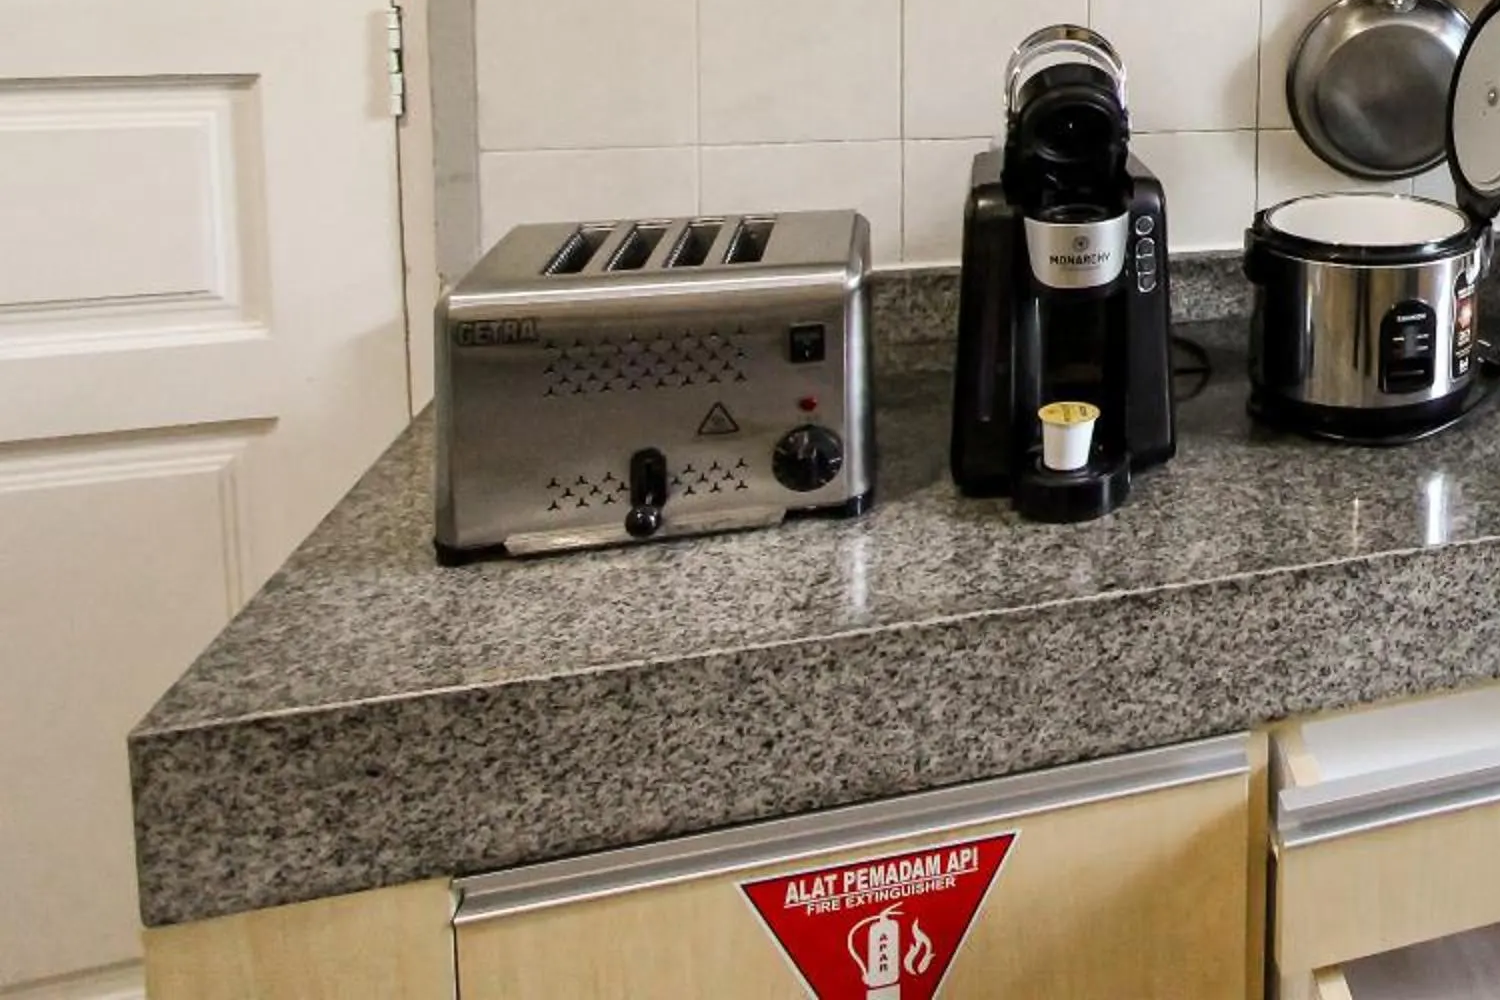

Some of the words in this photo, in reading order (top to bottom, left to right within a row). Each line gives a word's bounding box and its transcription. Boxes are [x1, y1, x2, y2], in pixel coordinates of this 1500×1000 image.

[1049, 252, 1111, 265] MONARCHY
[457, 318, 538, 346] GETRA
[785, 874, 838, 905] ALAT
[843, 854, 941, 894] PEMADAM
[947, 847, 978, 873] API
[806, 899, 840, 916] FIRE
[845, 874, 957, 909] EXTINGUISHER
